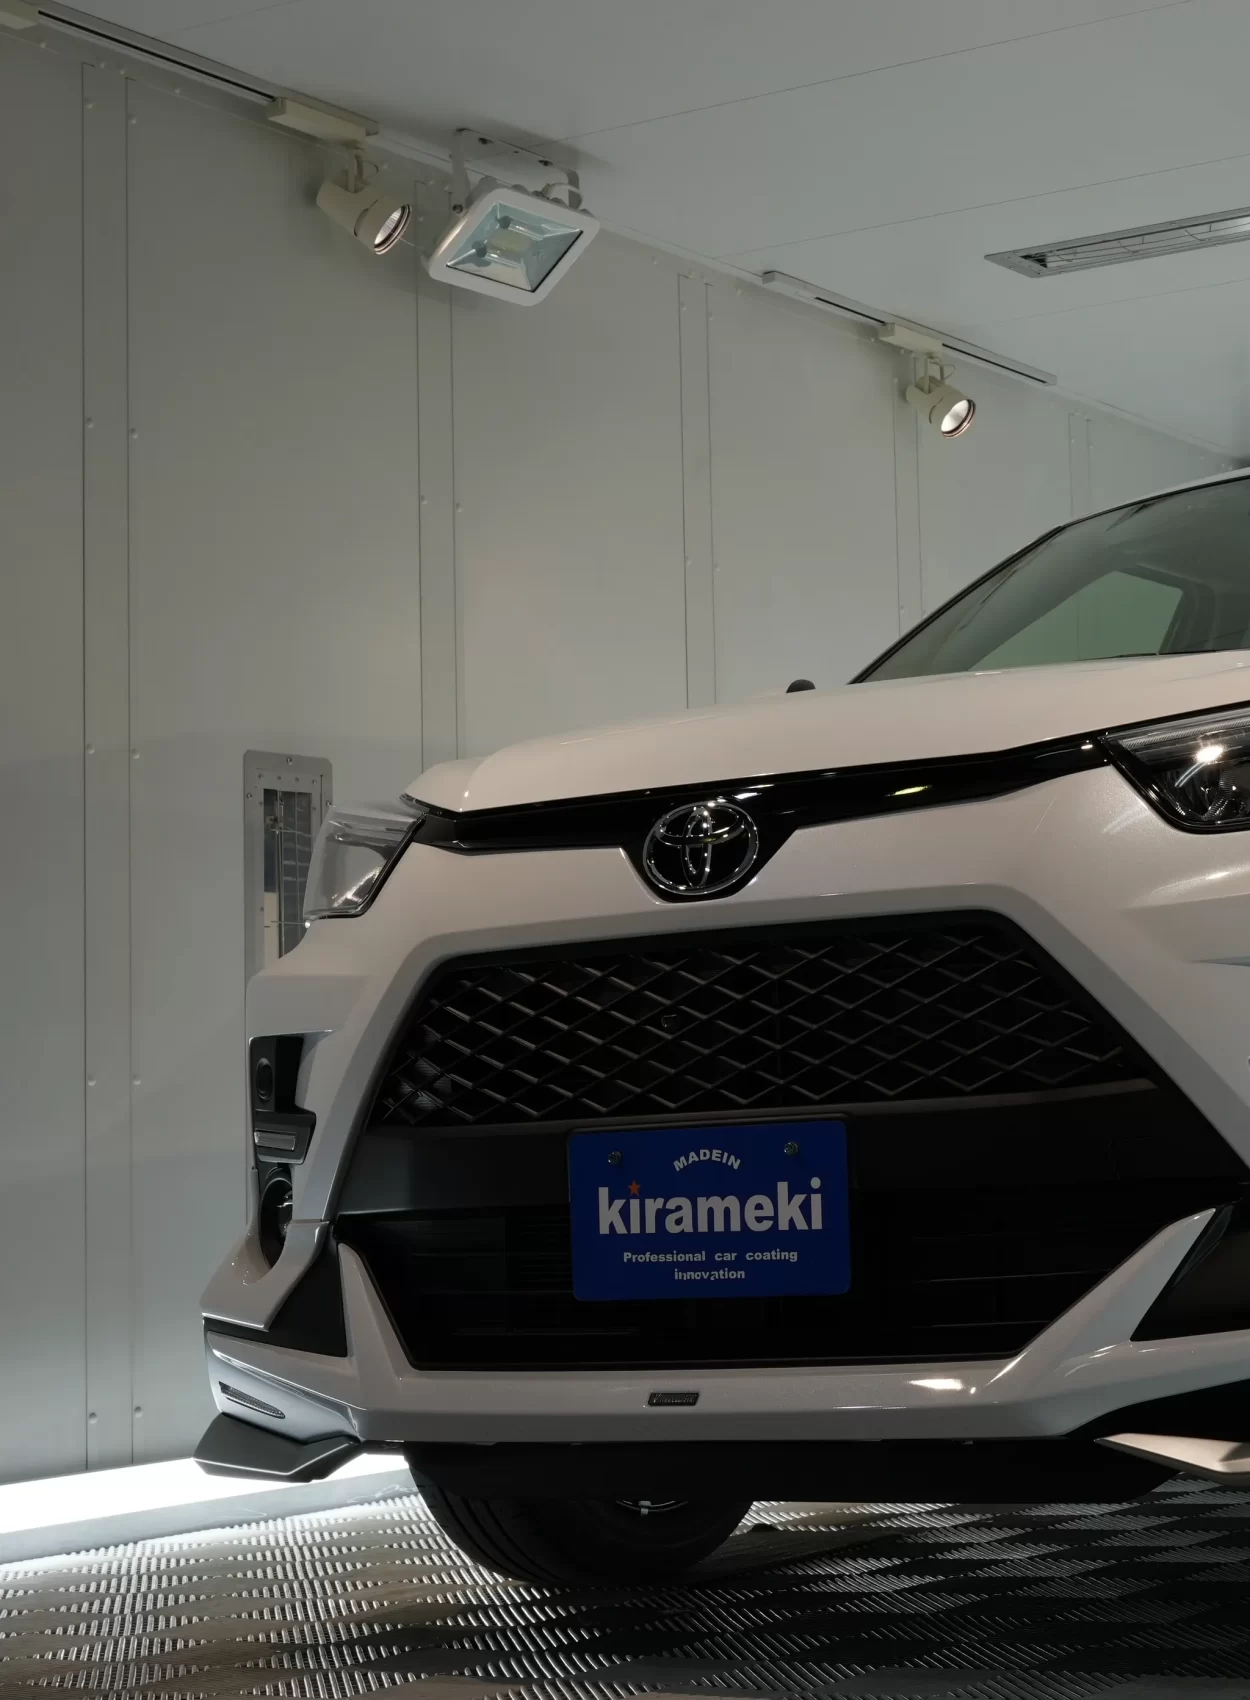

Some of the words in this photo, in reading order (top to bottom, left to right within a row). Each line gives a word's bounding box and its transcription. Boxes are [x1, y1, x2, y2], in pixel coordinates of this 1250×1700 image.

[673, 1149, 741, 1172] MADEIN
[598, 1176, 823, 1235] kirameki
[623, 1250, 706, 1263] Professional
[714, 1251, 738, 1262] car
[745, 1248, 798, 1263] coating
[674, 1268, 746, 1281] innovation
